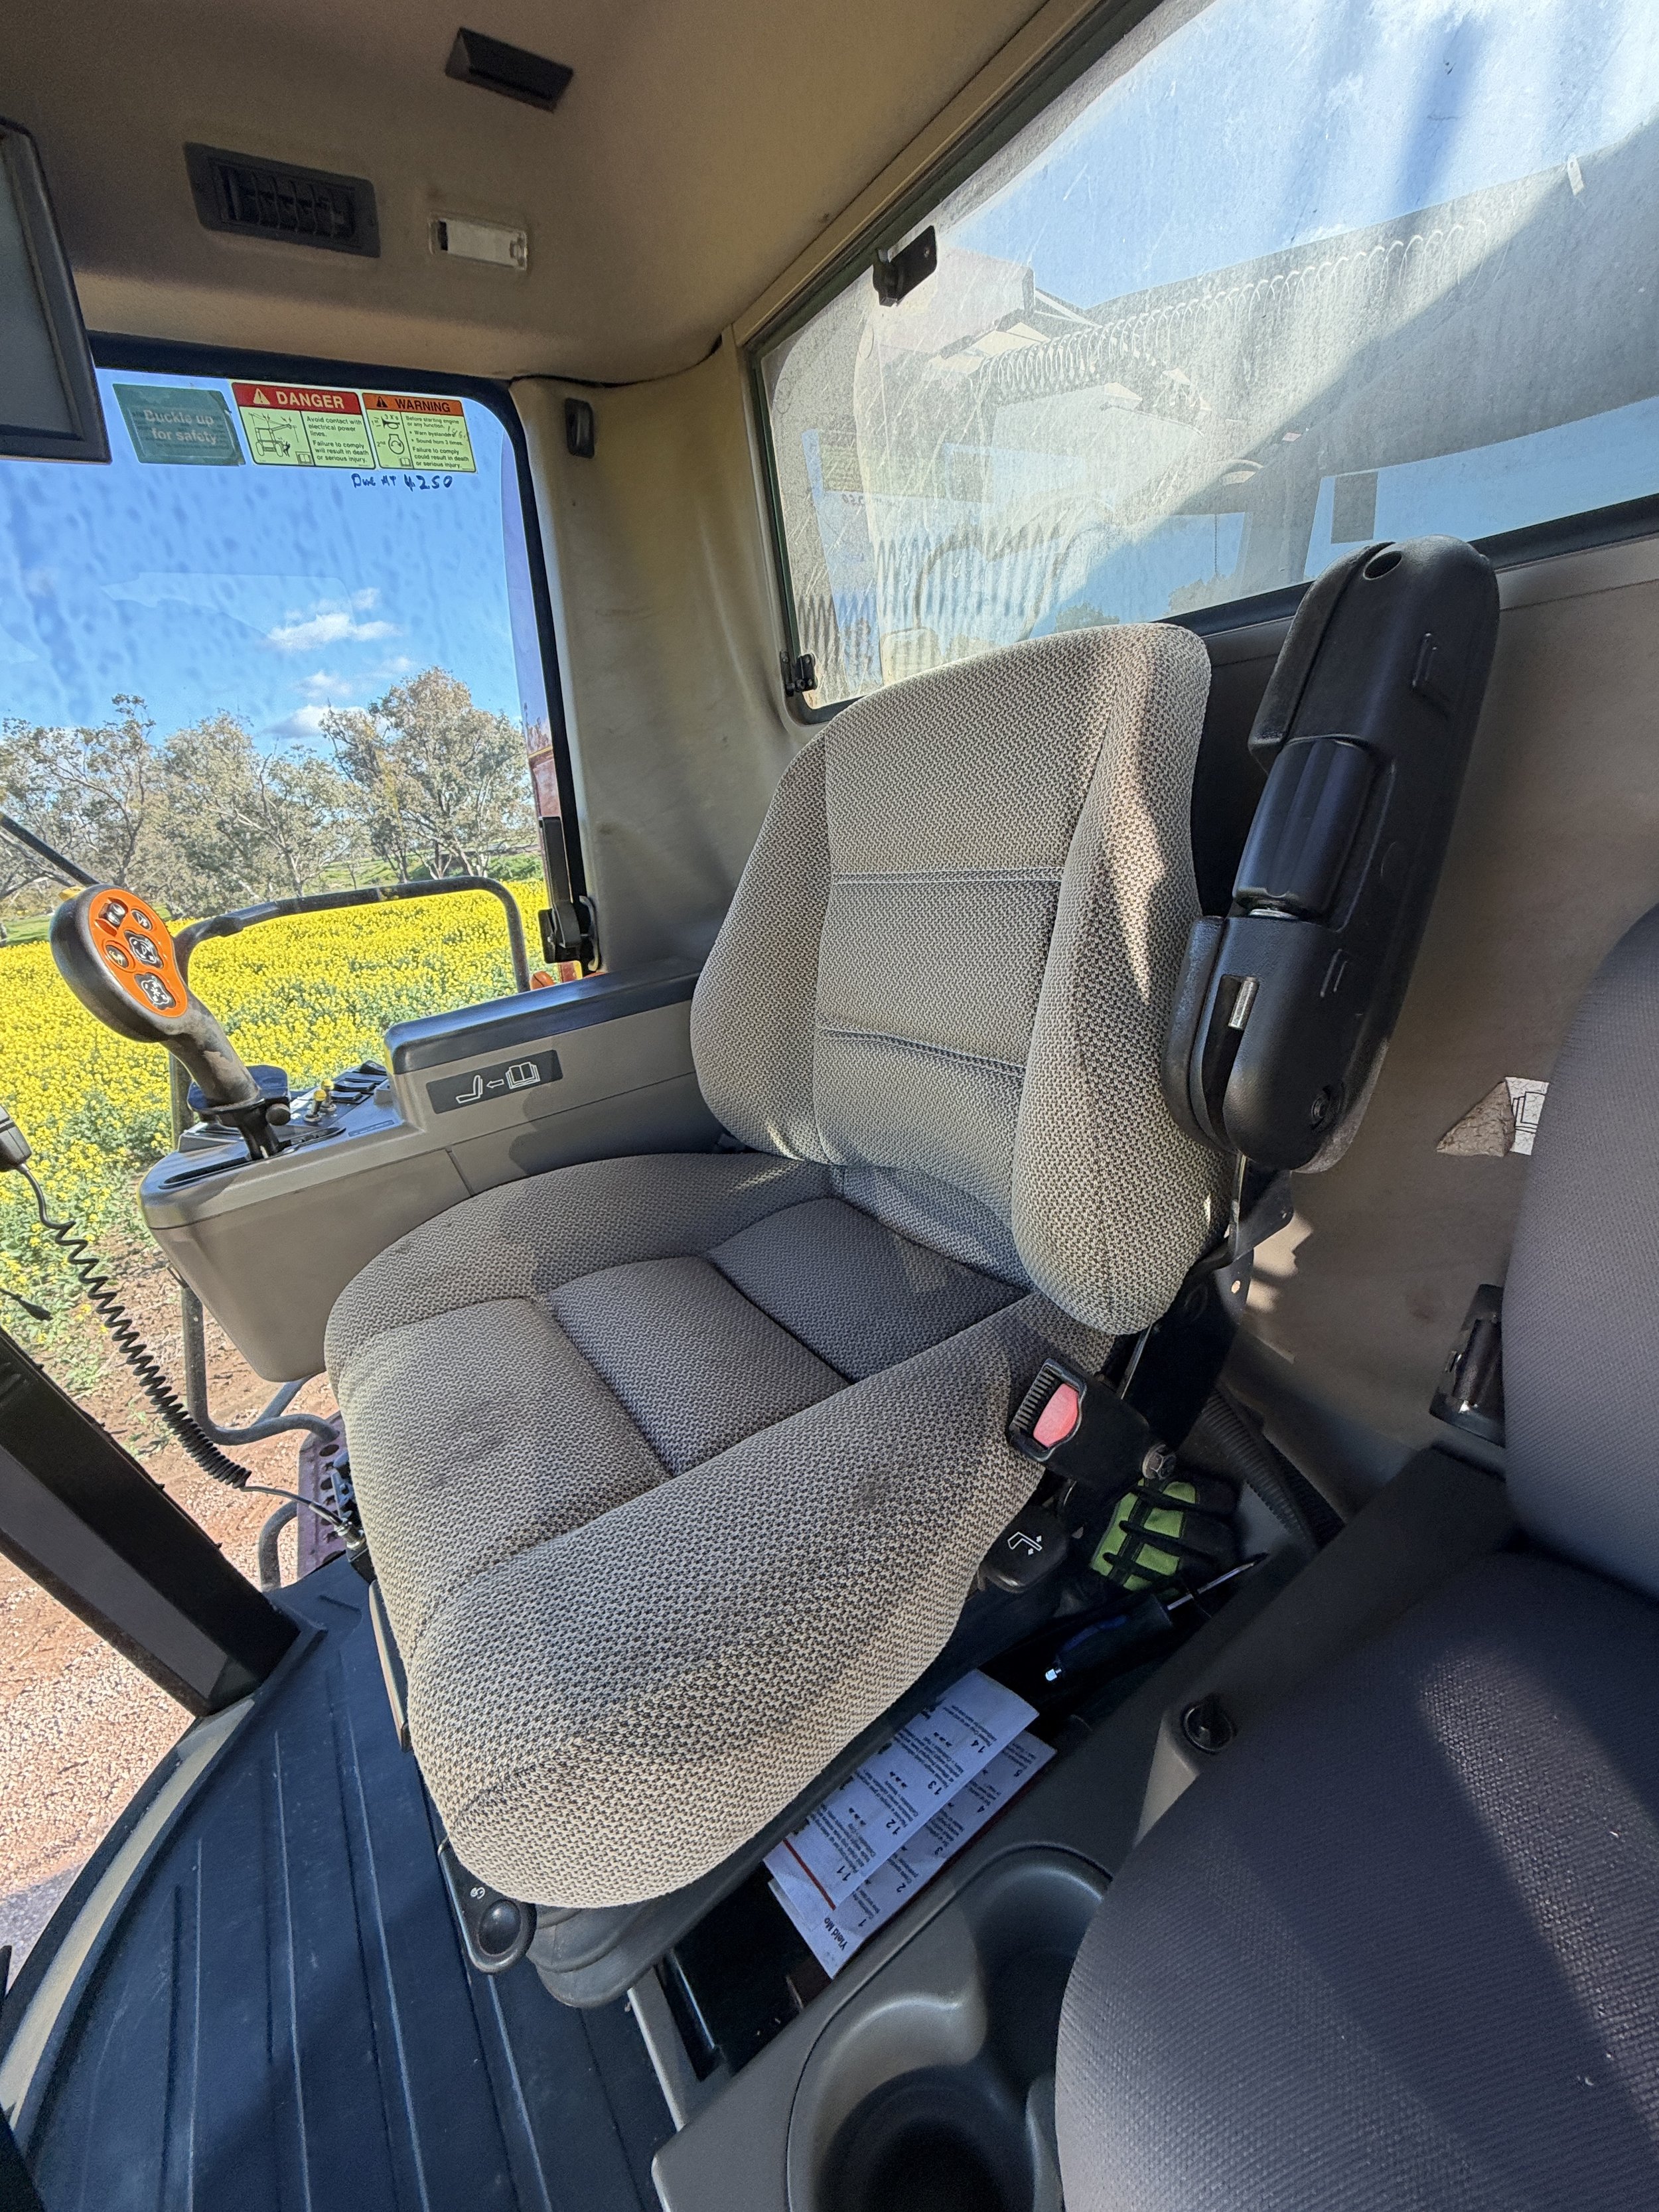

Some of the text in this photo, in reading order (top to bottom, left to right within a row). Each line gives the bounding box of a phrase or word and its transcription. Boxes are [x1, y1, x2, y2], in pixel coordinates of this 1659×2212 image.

[275, 391, 344, 409] DANGER
[395, 399, 451, 412] WARNING
[143, 409, 214, 427] Buckle up
[151, 427, 216, 445] for safety
[351, 473, 376, 488] Due
[404, 474, 453, 492] 4250
[934, 1847, 943, 1855] 3
[896, 1883, 906, 1893] 2
[858, 1918, 867, 1927] 1
[830, 1928, 848, 1951] Yield
